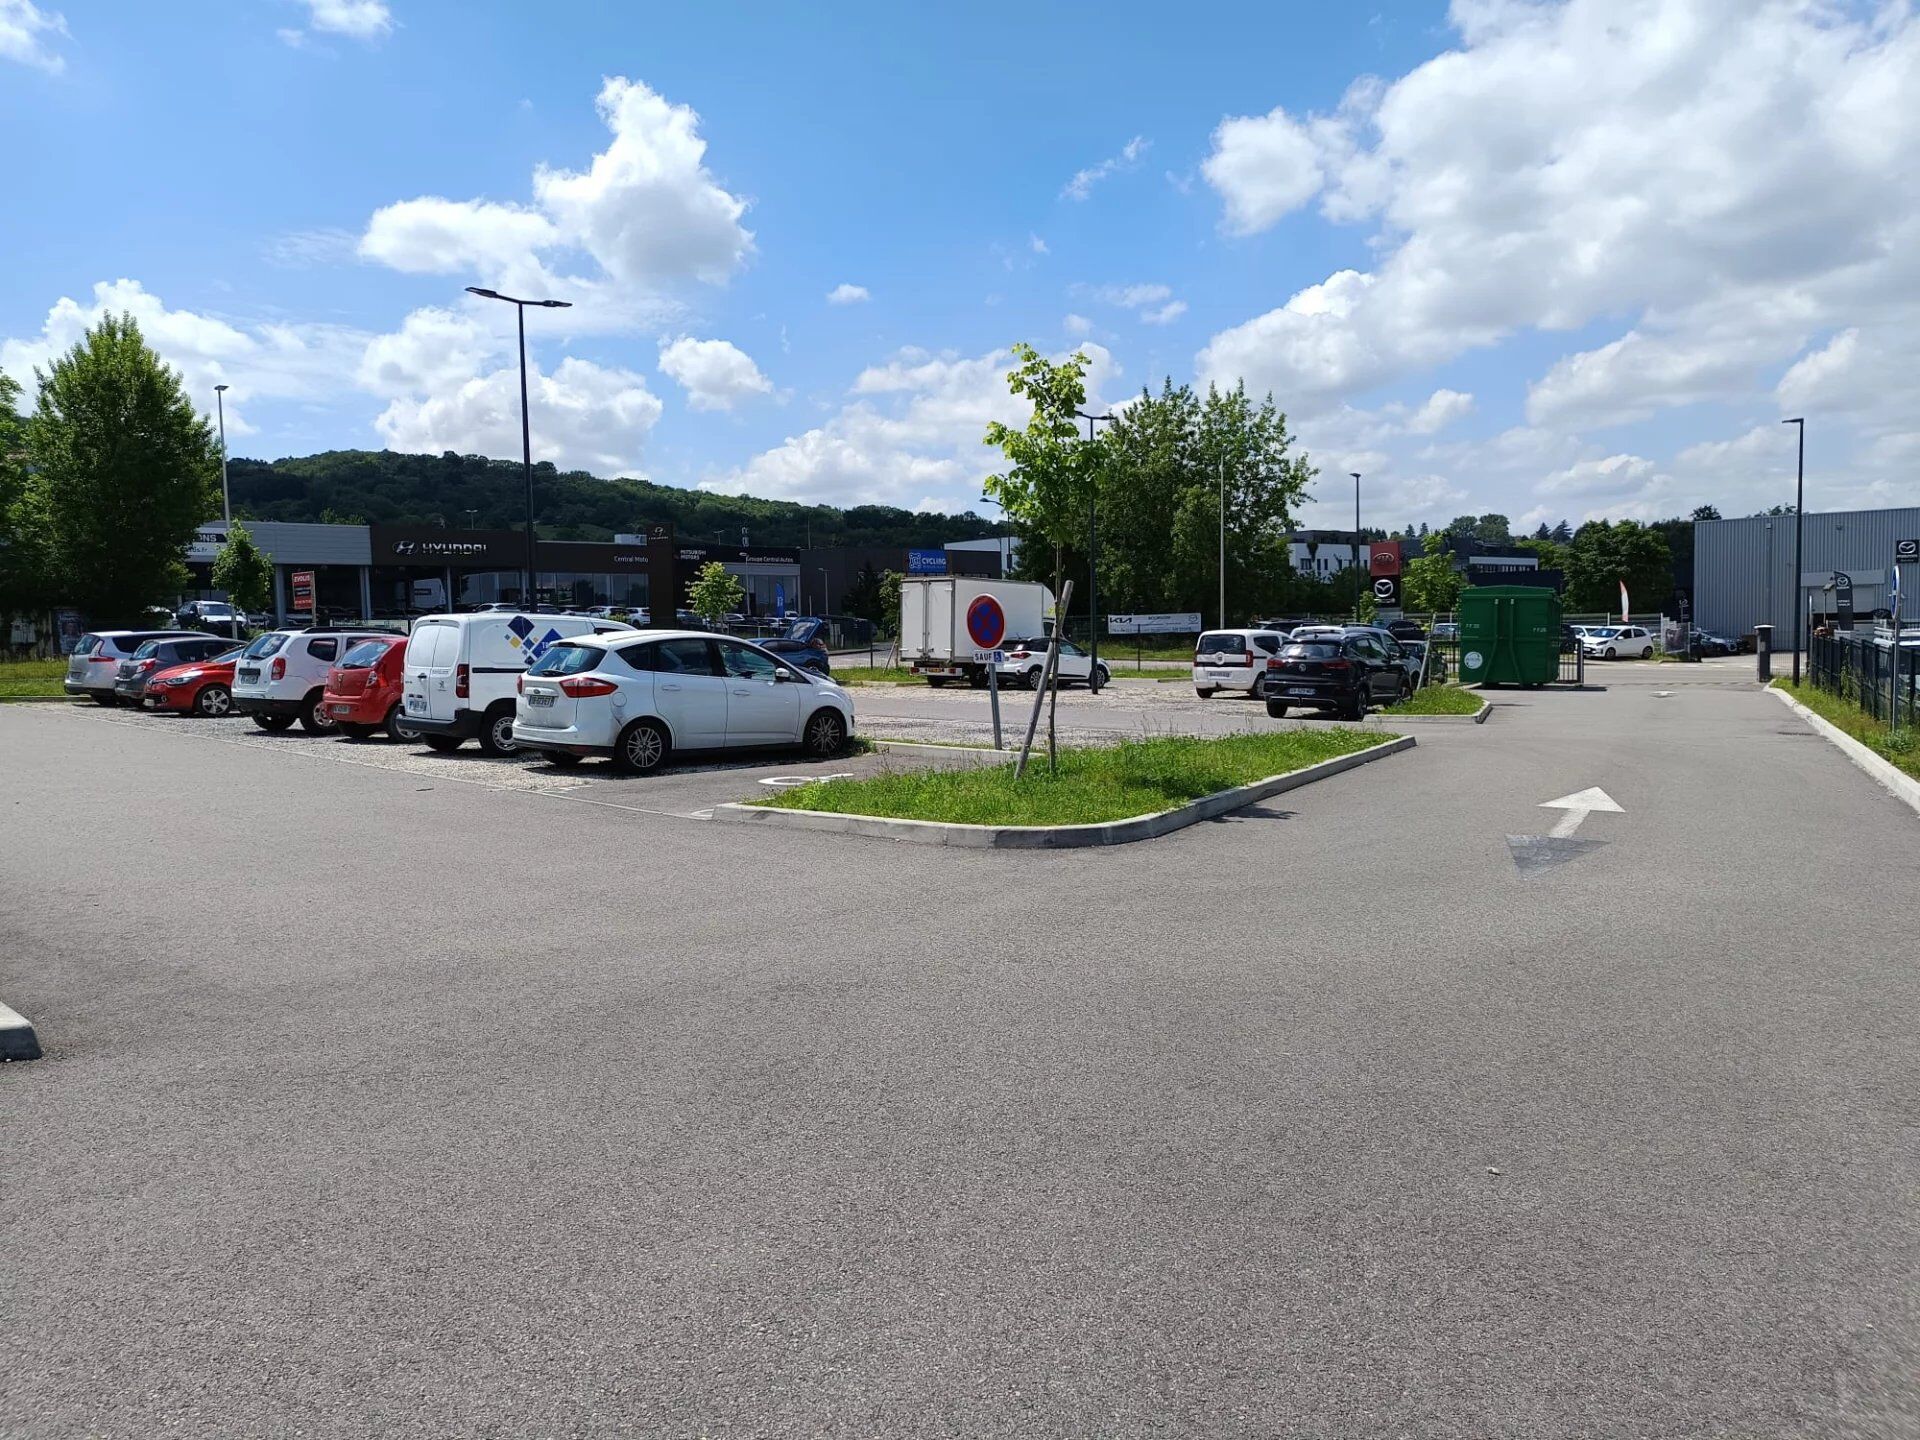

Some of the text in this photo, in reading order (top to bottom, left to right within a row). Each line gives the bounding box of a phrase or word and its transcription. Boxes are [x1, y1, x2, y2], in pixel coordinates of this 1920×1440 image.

[422, 543, 487, 554] HYUNDAI
[921, 557, 947, 565] CYCLING
[974, 653, 992, 661] SAUF
